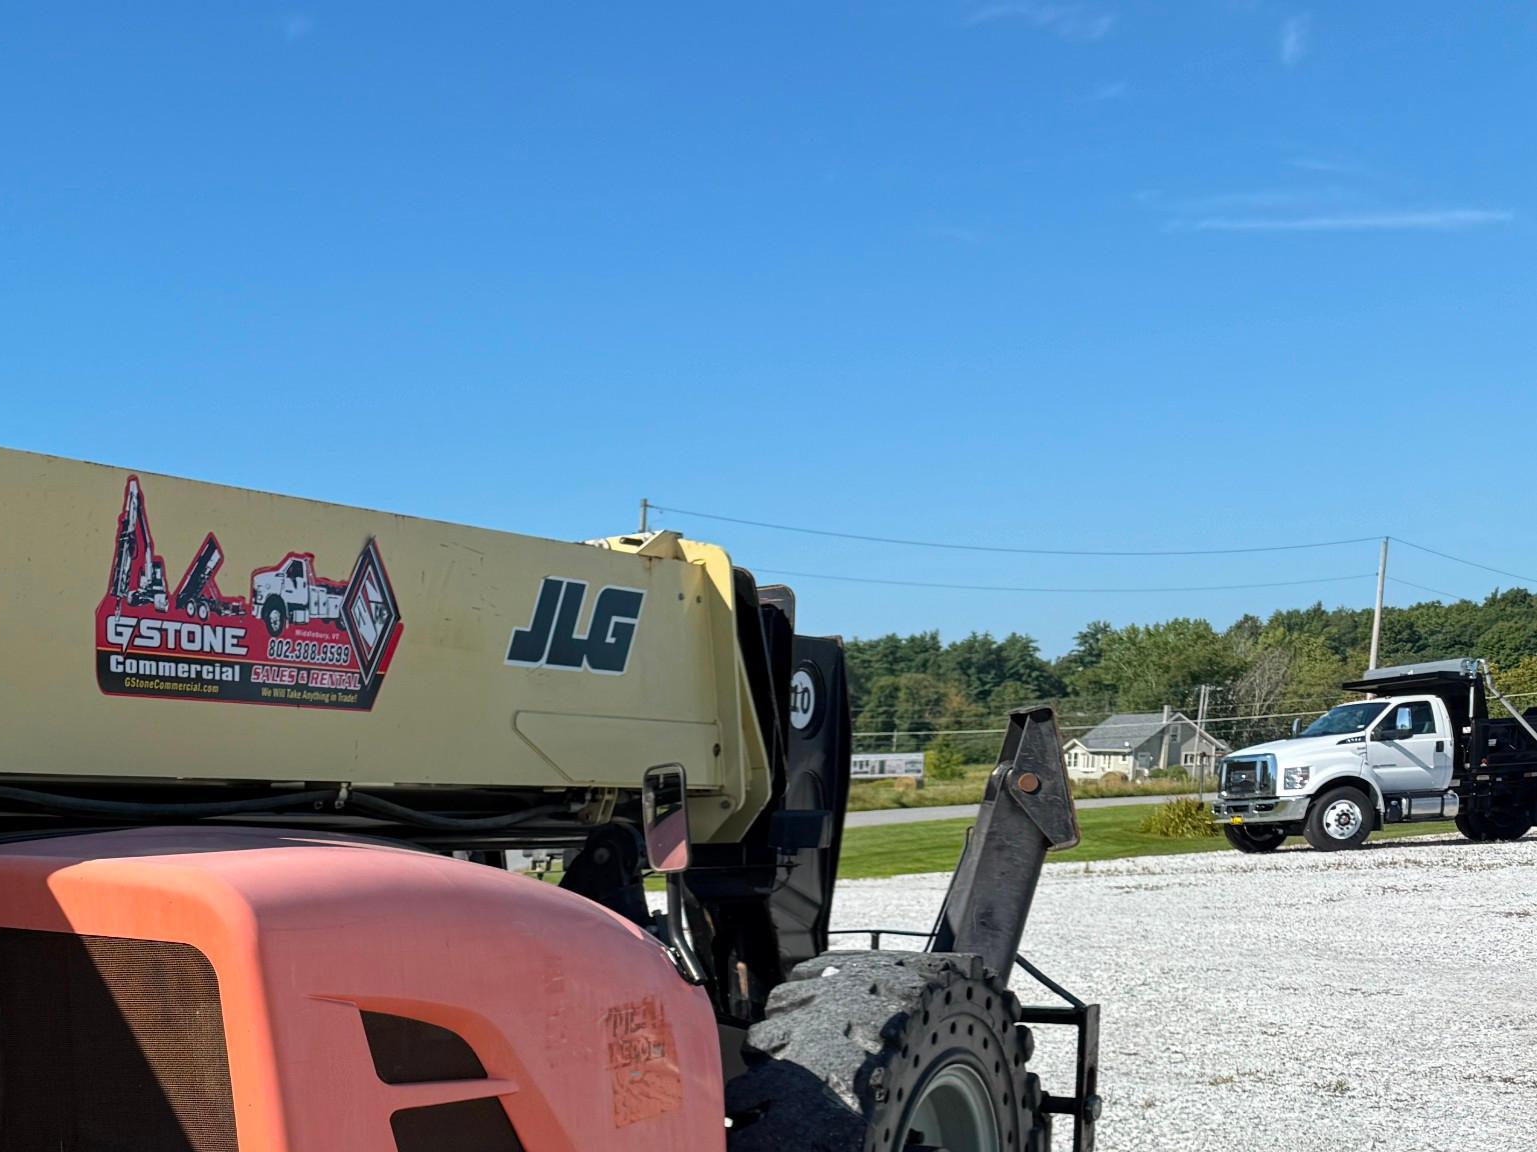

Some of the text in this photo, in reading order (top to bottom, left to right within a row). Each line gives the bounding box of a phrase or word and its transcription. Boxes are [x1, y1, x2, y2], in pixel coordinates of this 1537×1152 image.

[106, 615, 248, 656] GSTONE
[505, 576, 647, 676] JLG
[267, 638, 351, 665] 802.388.9599
[110, 655, 240, 681] Commercial
[251, 665, 361, 690] SALES & RENTAL
[124, 677, 219, 693] GStoneCommercial.com
[261, 687, 271, 697] We
[791, 684, 811, 714] 10
